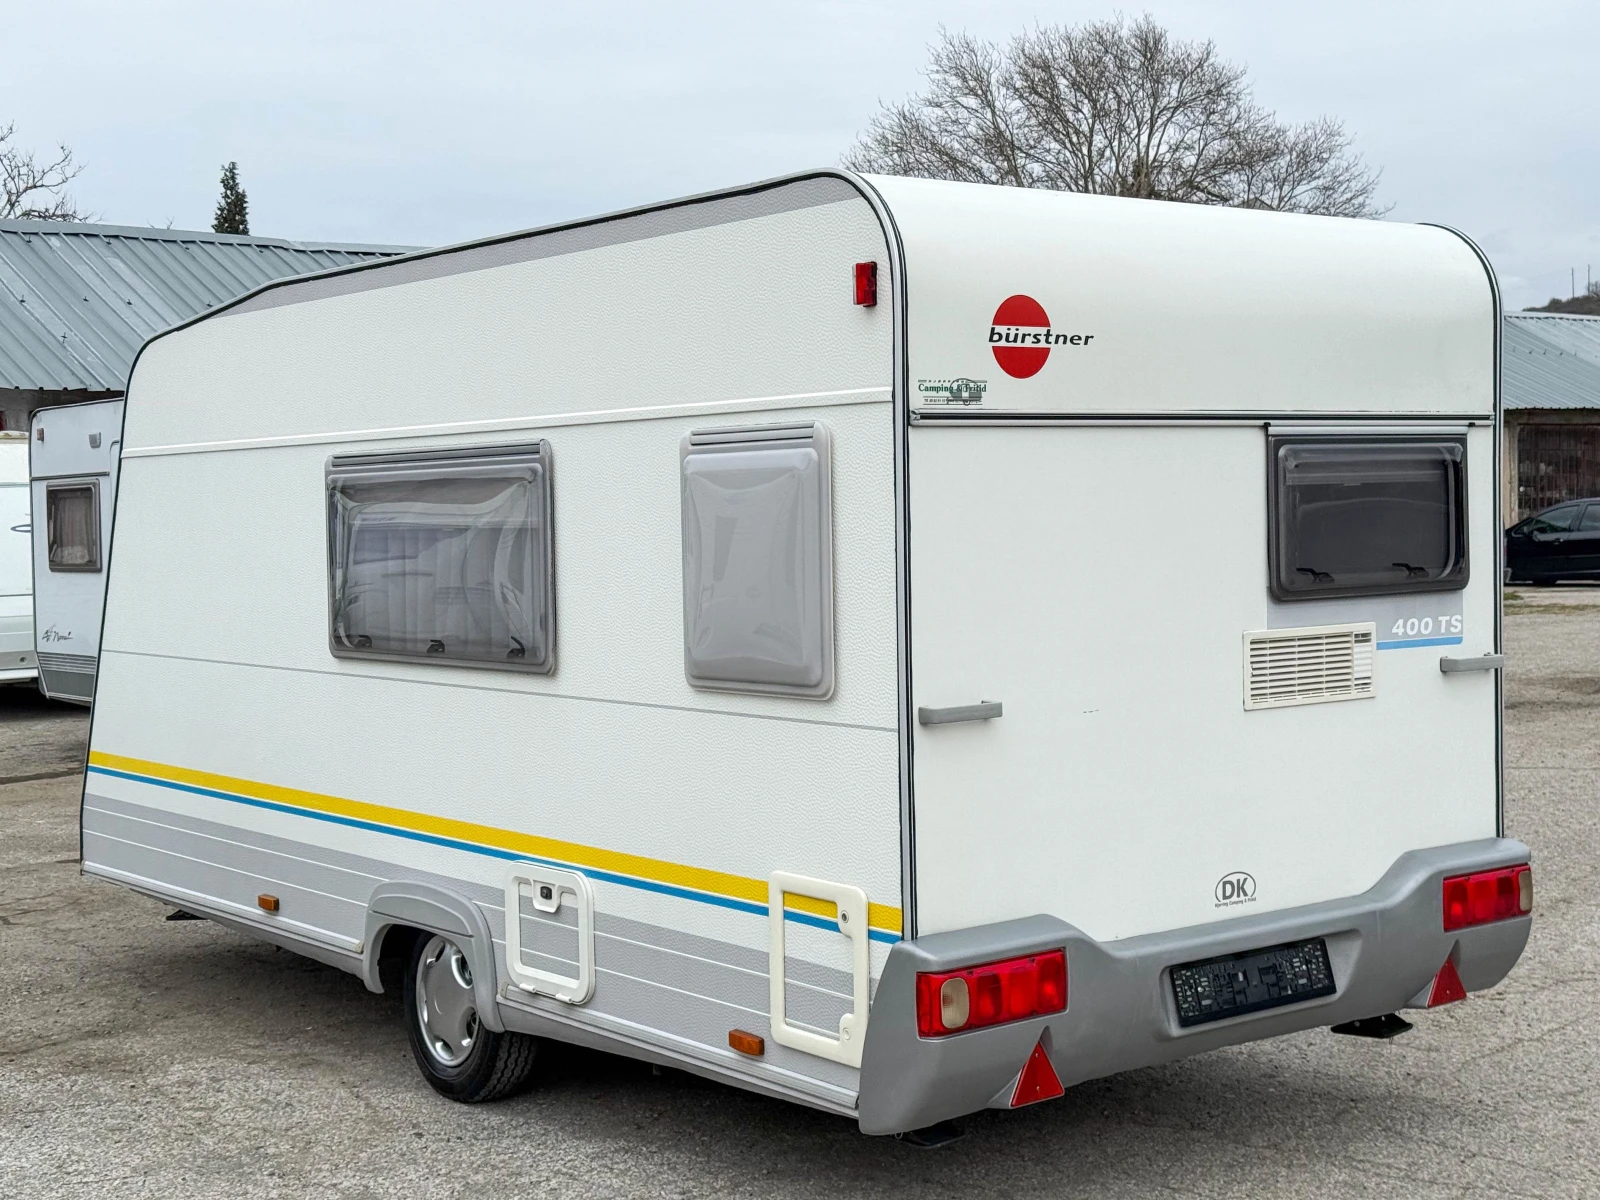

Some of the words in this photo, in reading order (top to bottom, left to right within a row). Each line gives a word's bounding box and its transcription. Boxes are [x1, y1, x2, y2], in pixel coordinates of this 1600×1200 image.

[988, 327, 1094, 346] bürstner
[918, 383, 954, 393] Camping
[1391, 617, 1433, 636] 400
[1437, 614, 1462, 634] TS
[1222, 877, 1248, 900] DK
